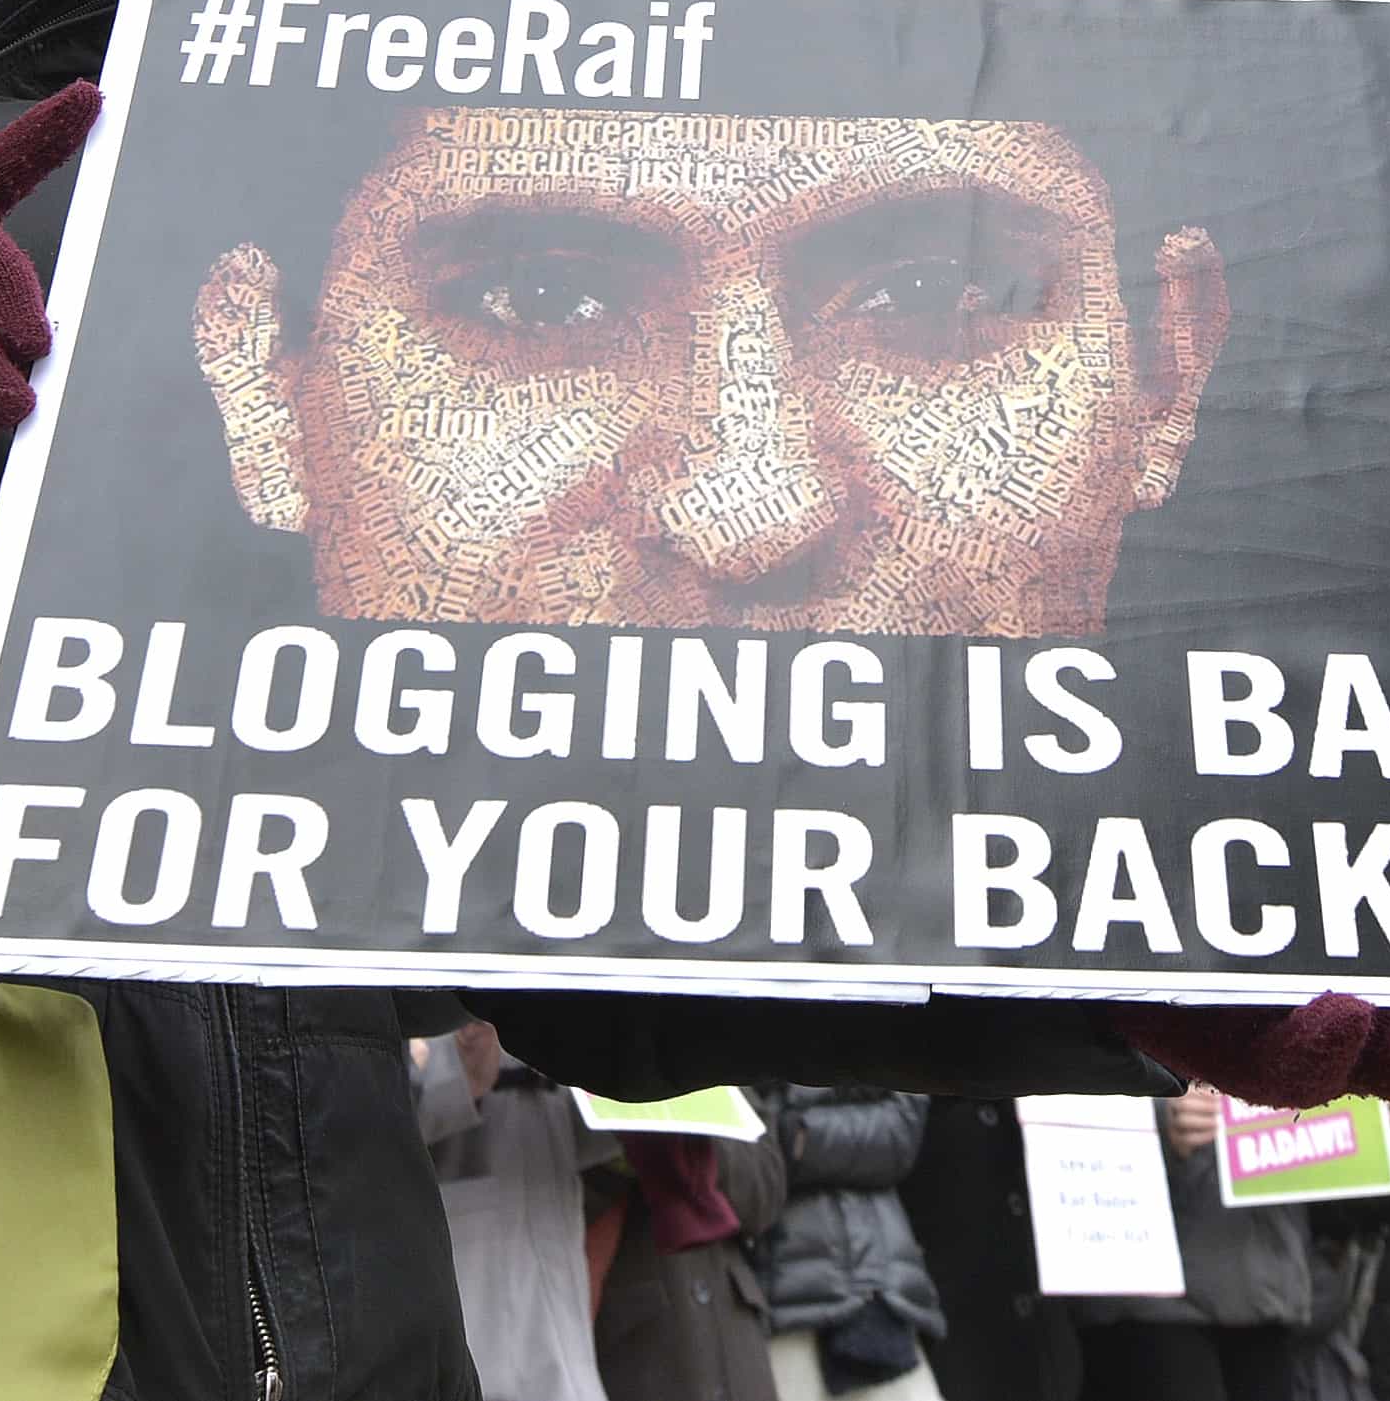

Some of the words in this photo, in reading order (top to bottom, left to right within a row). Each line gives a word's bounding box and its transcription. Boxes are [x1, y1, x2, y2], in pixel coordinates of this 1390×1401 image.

[9, 617, 885, 766] BLOGGING
[968, 646, 1122, 773] IS
[401, 799, 873, 945] YOUR
